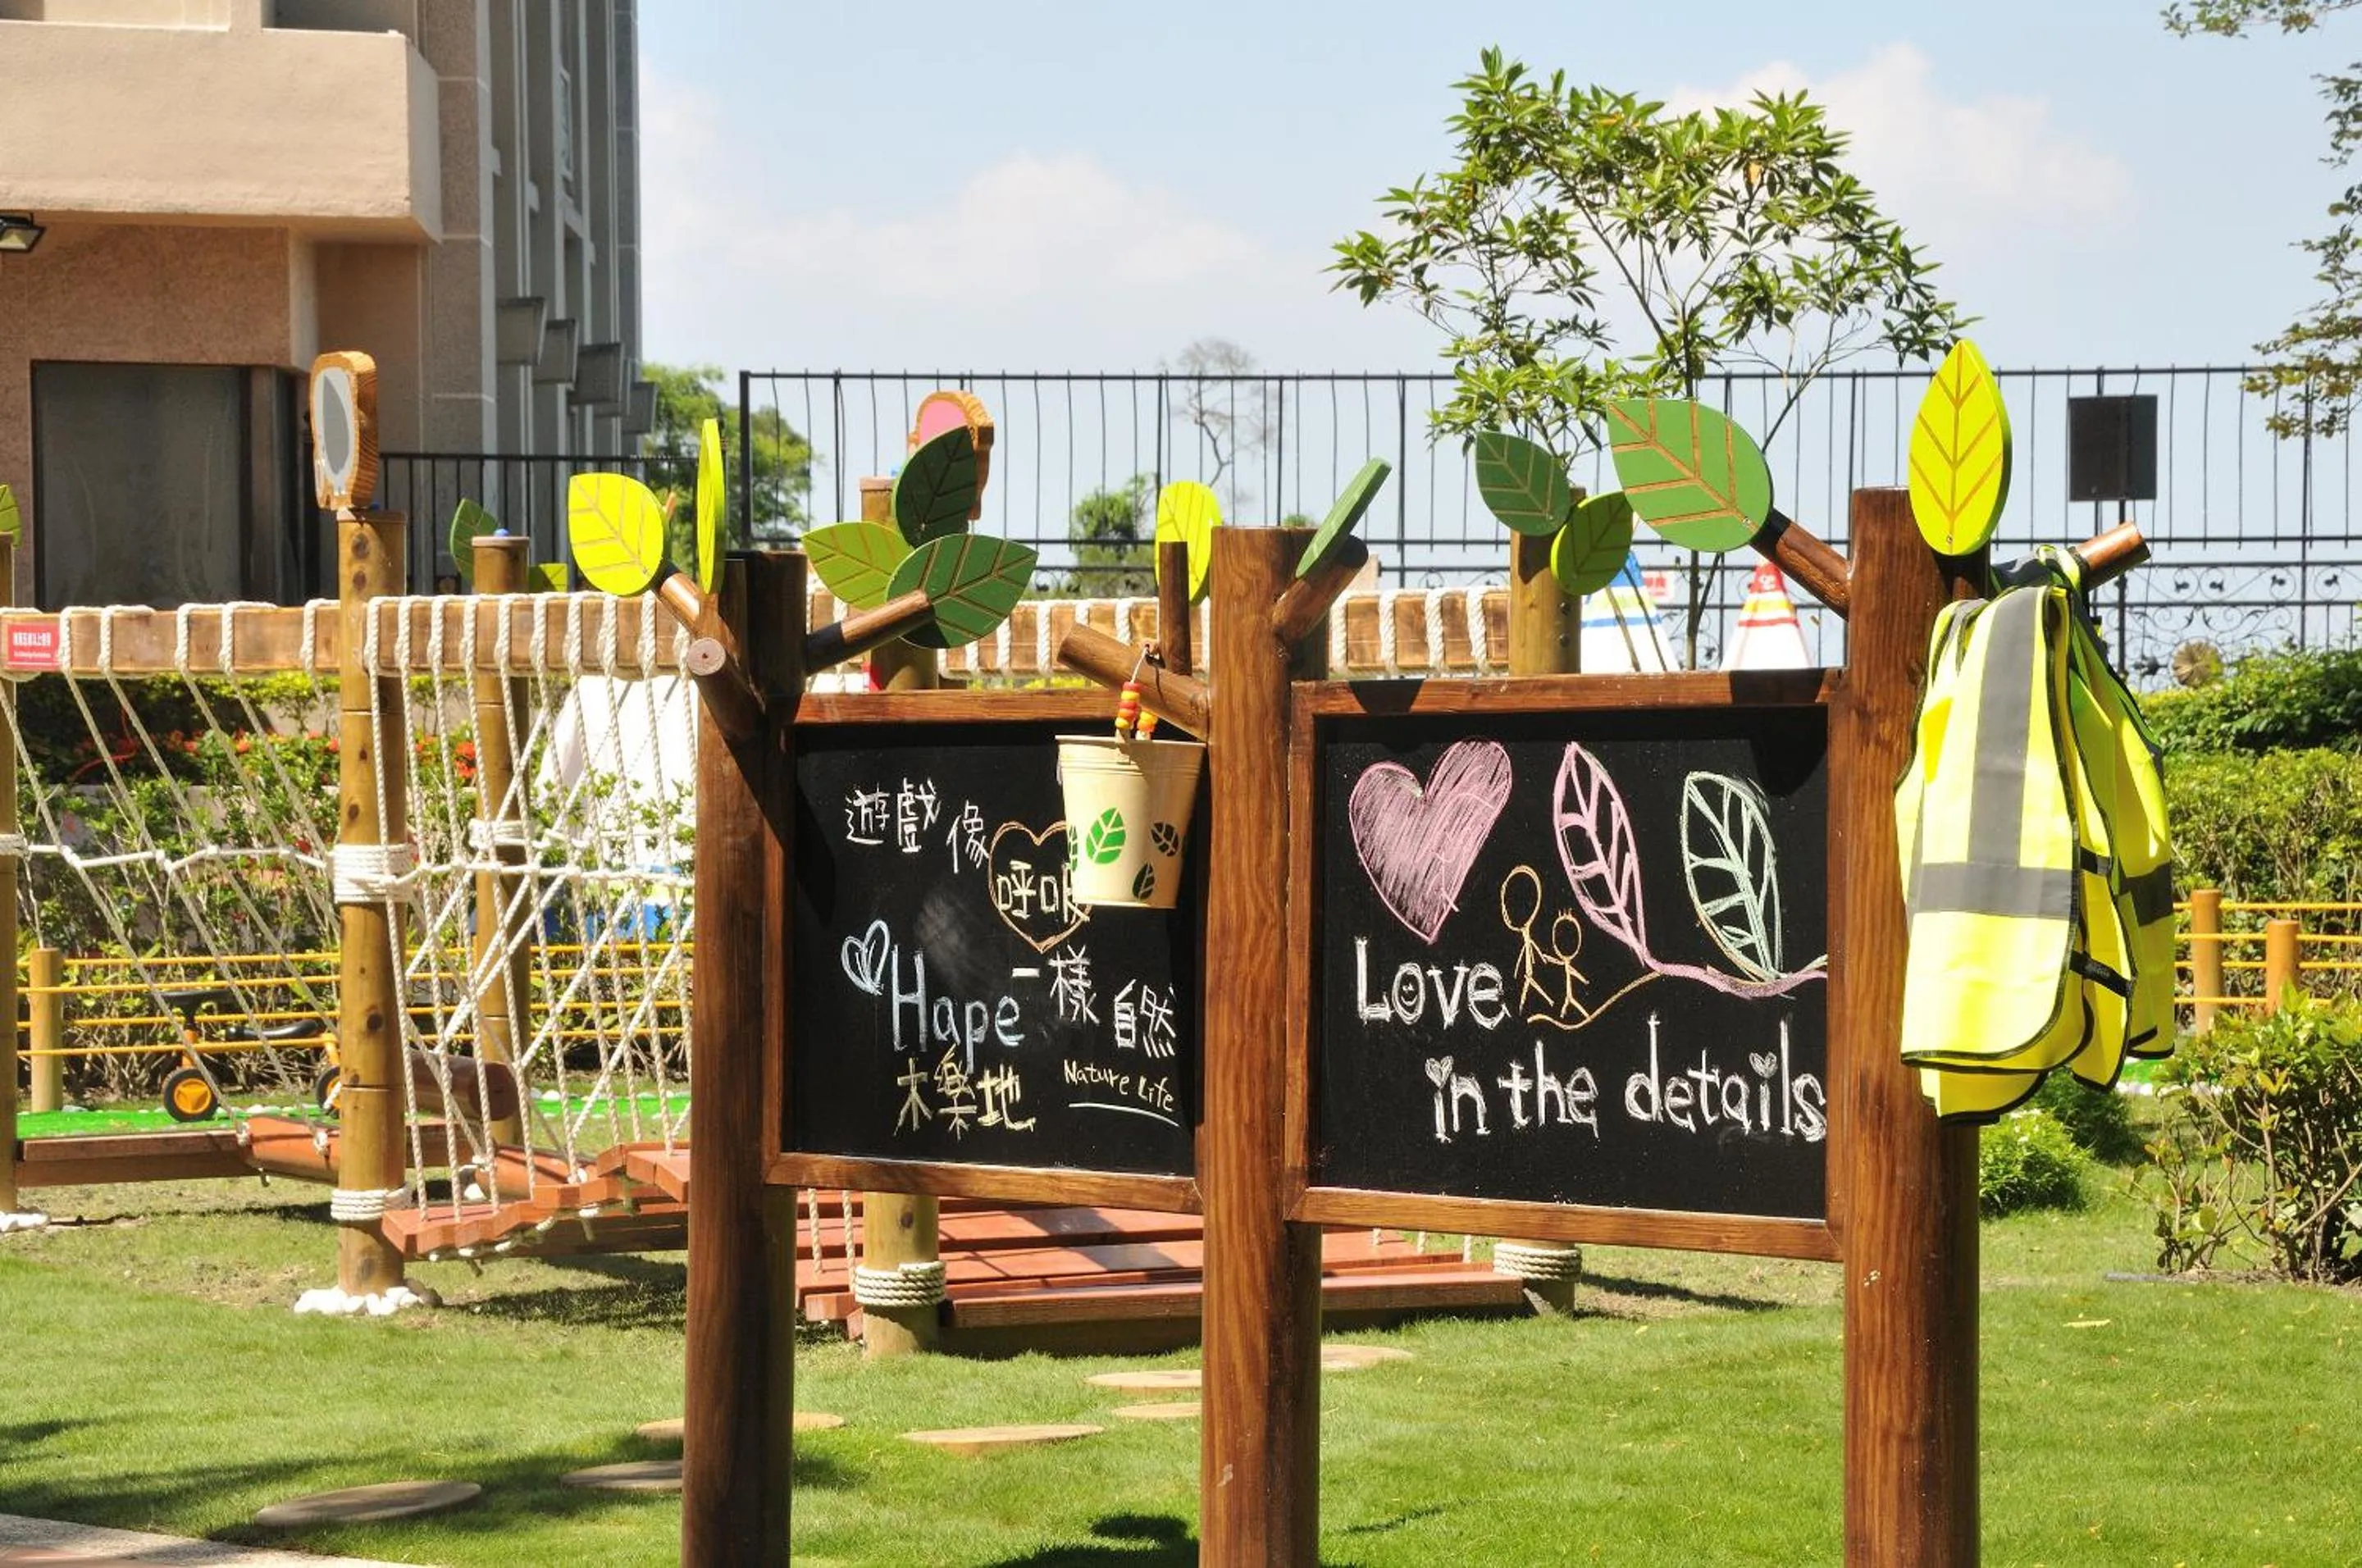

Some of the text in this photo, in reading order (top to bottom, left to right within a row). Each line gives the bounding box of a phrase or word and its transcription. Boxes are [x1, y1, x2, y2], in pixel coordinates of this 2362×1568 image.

[891, 945, 1027, 1075] Hape
[1356, 936, 1511, 1029] Love
[1065, 1059, 1175, 1112] Nature Life
[1425, 1012, 1826, 1143] in the details
